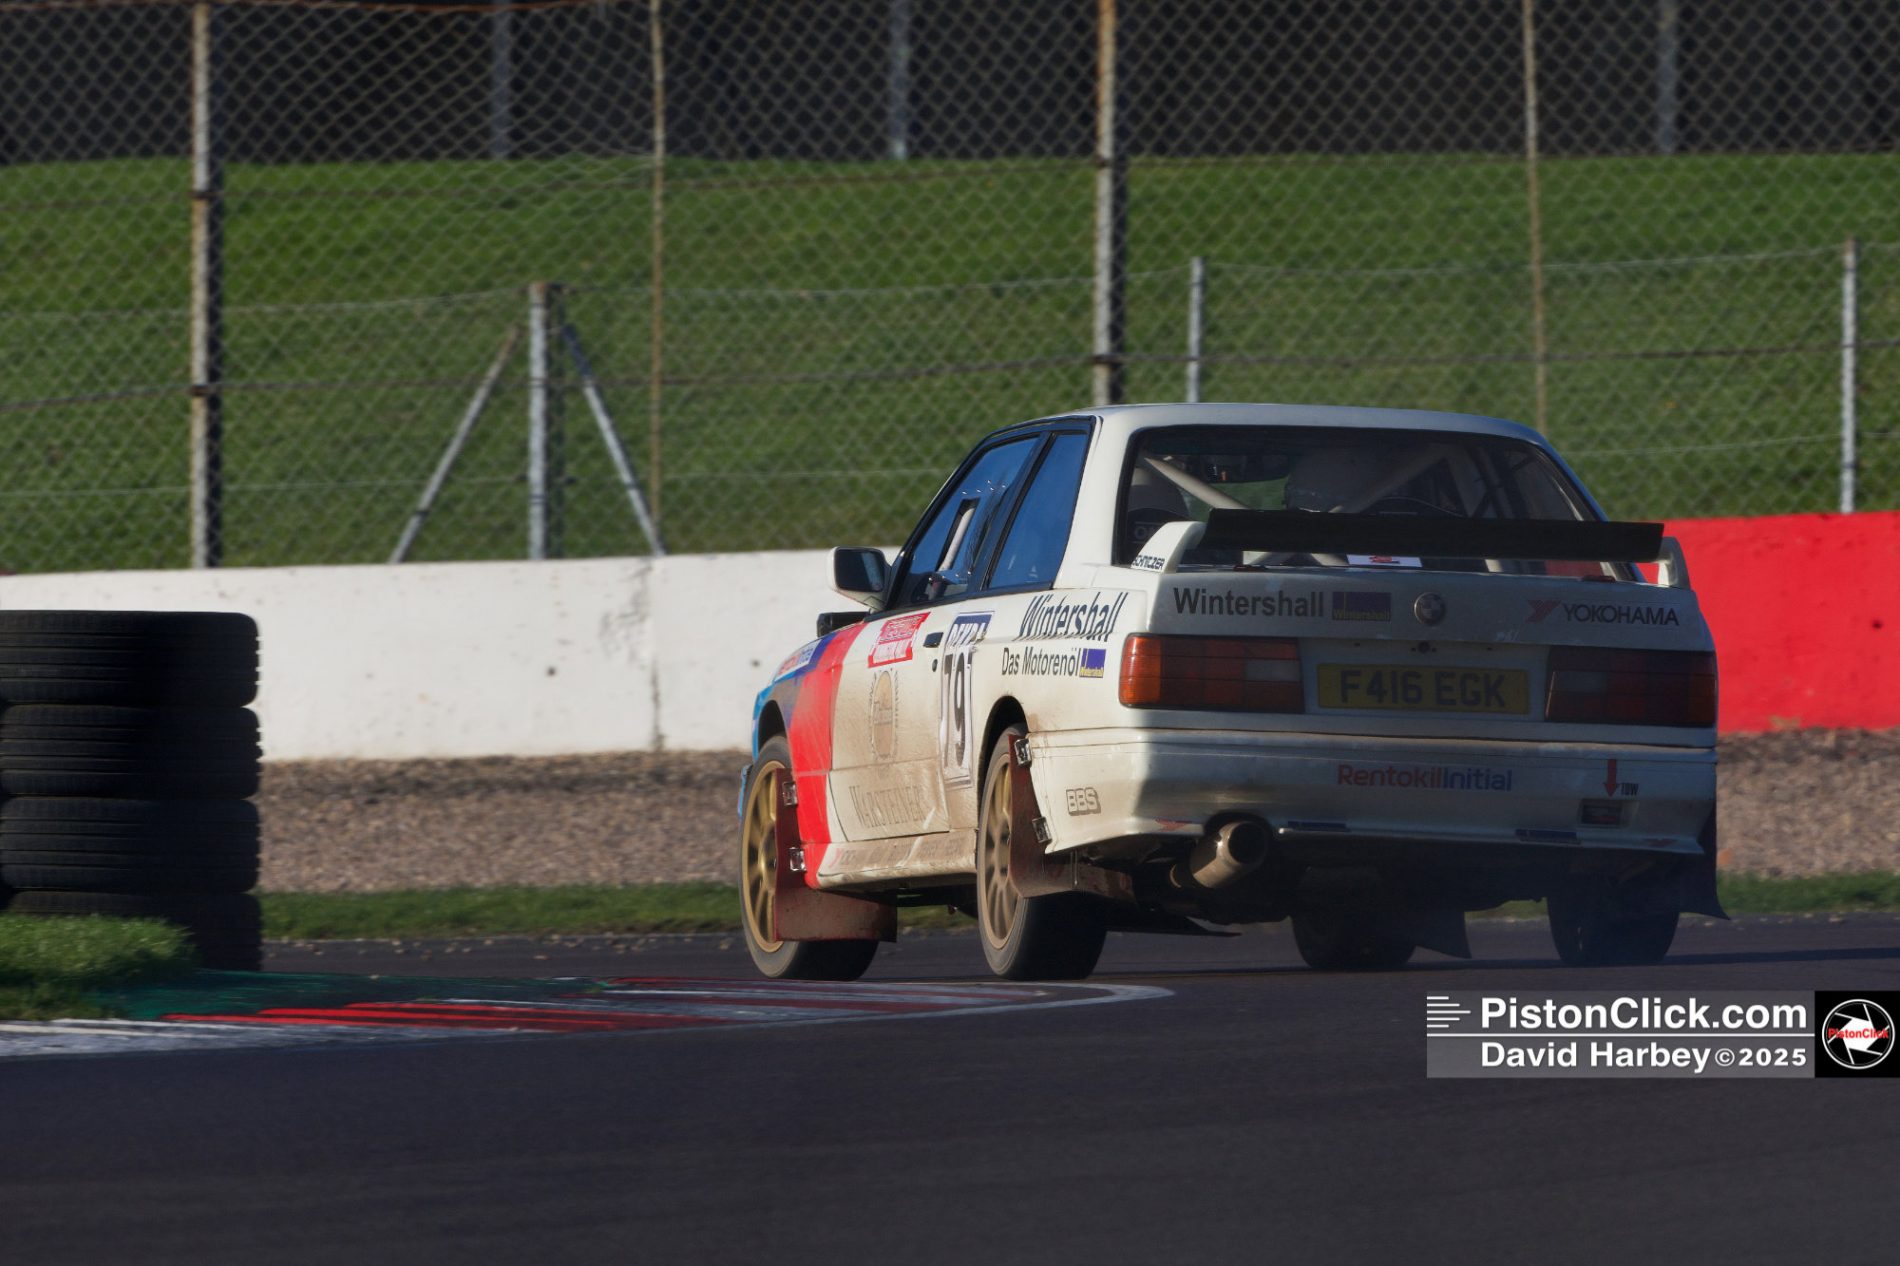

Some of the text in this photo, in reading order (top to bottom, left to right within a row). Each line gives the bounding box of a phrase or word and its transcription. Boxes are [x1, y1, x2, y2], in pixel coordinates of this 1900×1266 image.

[1012, 592, 1129, 642] Wintershall
[1173, 587, 1324, 617] Wintershall
[1564, 603, 1680, 626] YOKOHAMA
[1001, 646, 1081, 676] Das Motorenöl
[1340, 670, 1506, 707] F416 EGK
[1066, 787, 1101, 816] BBS
